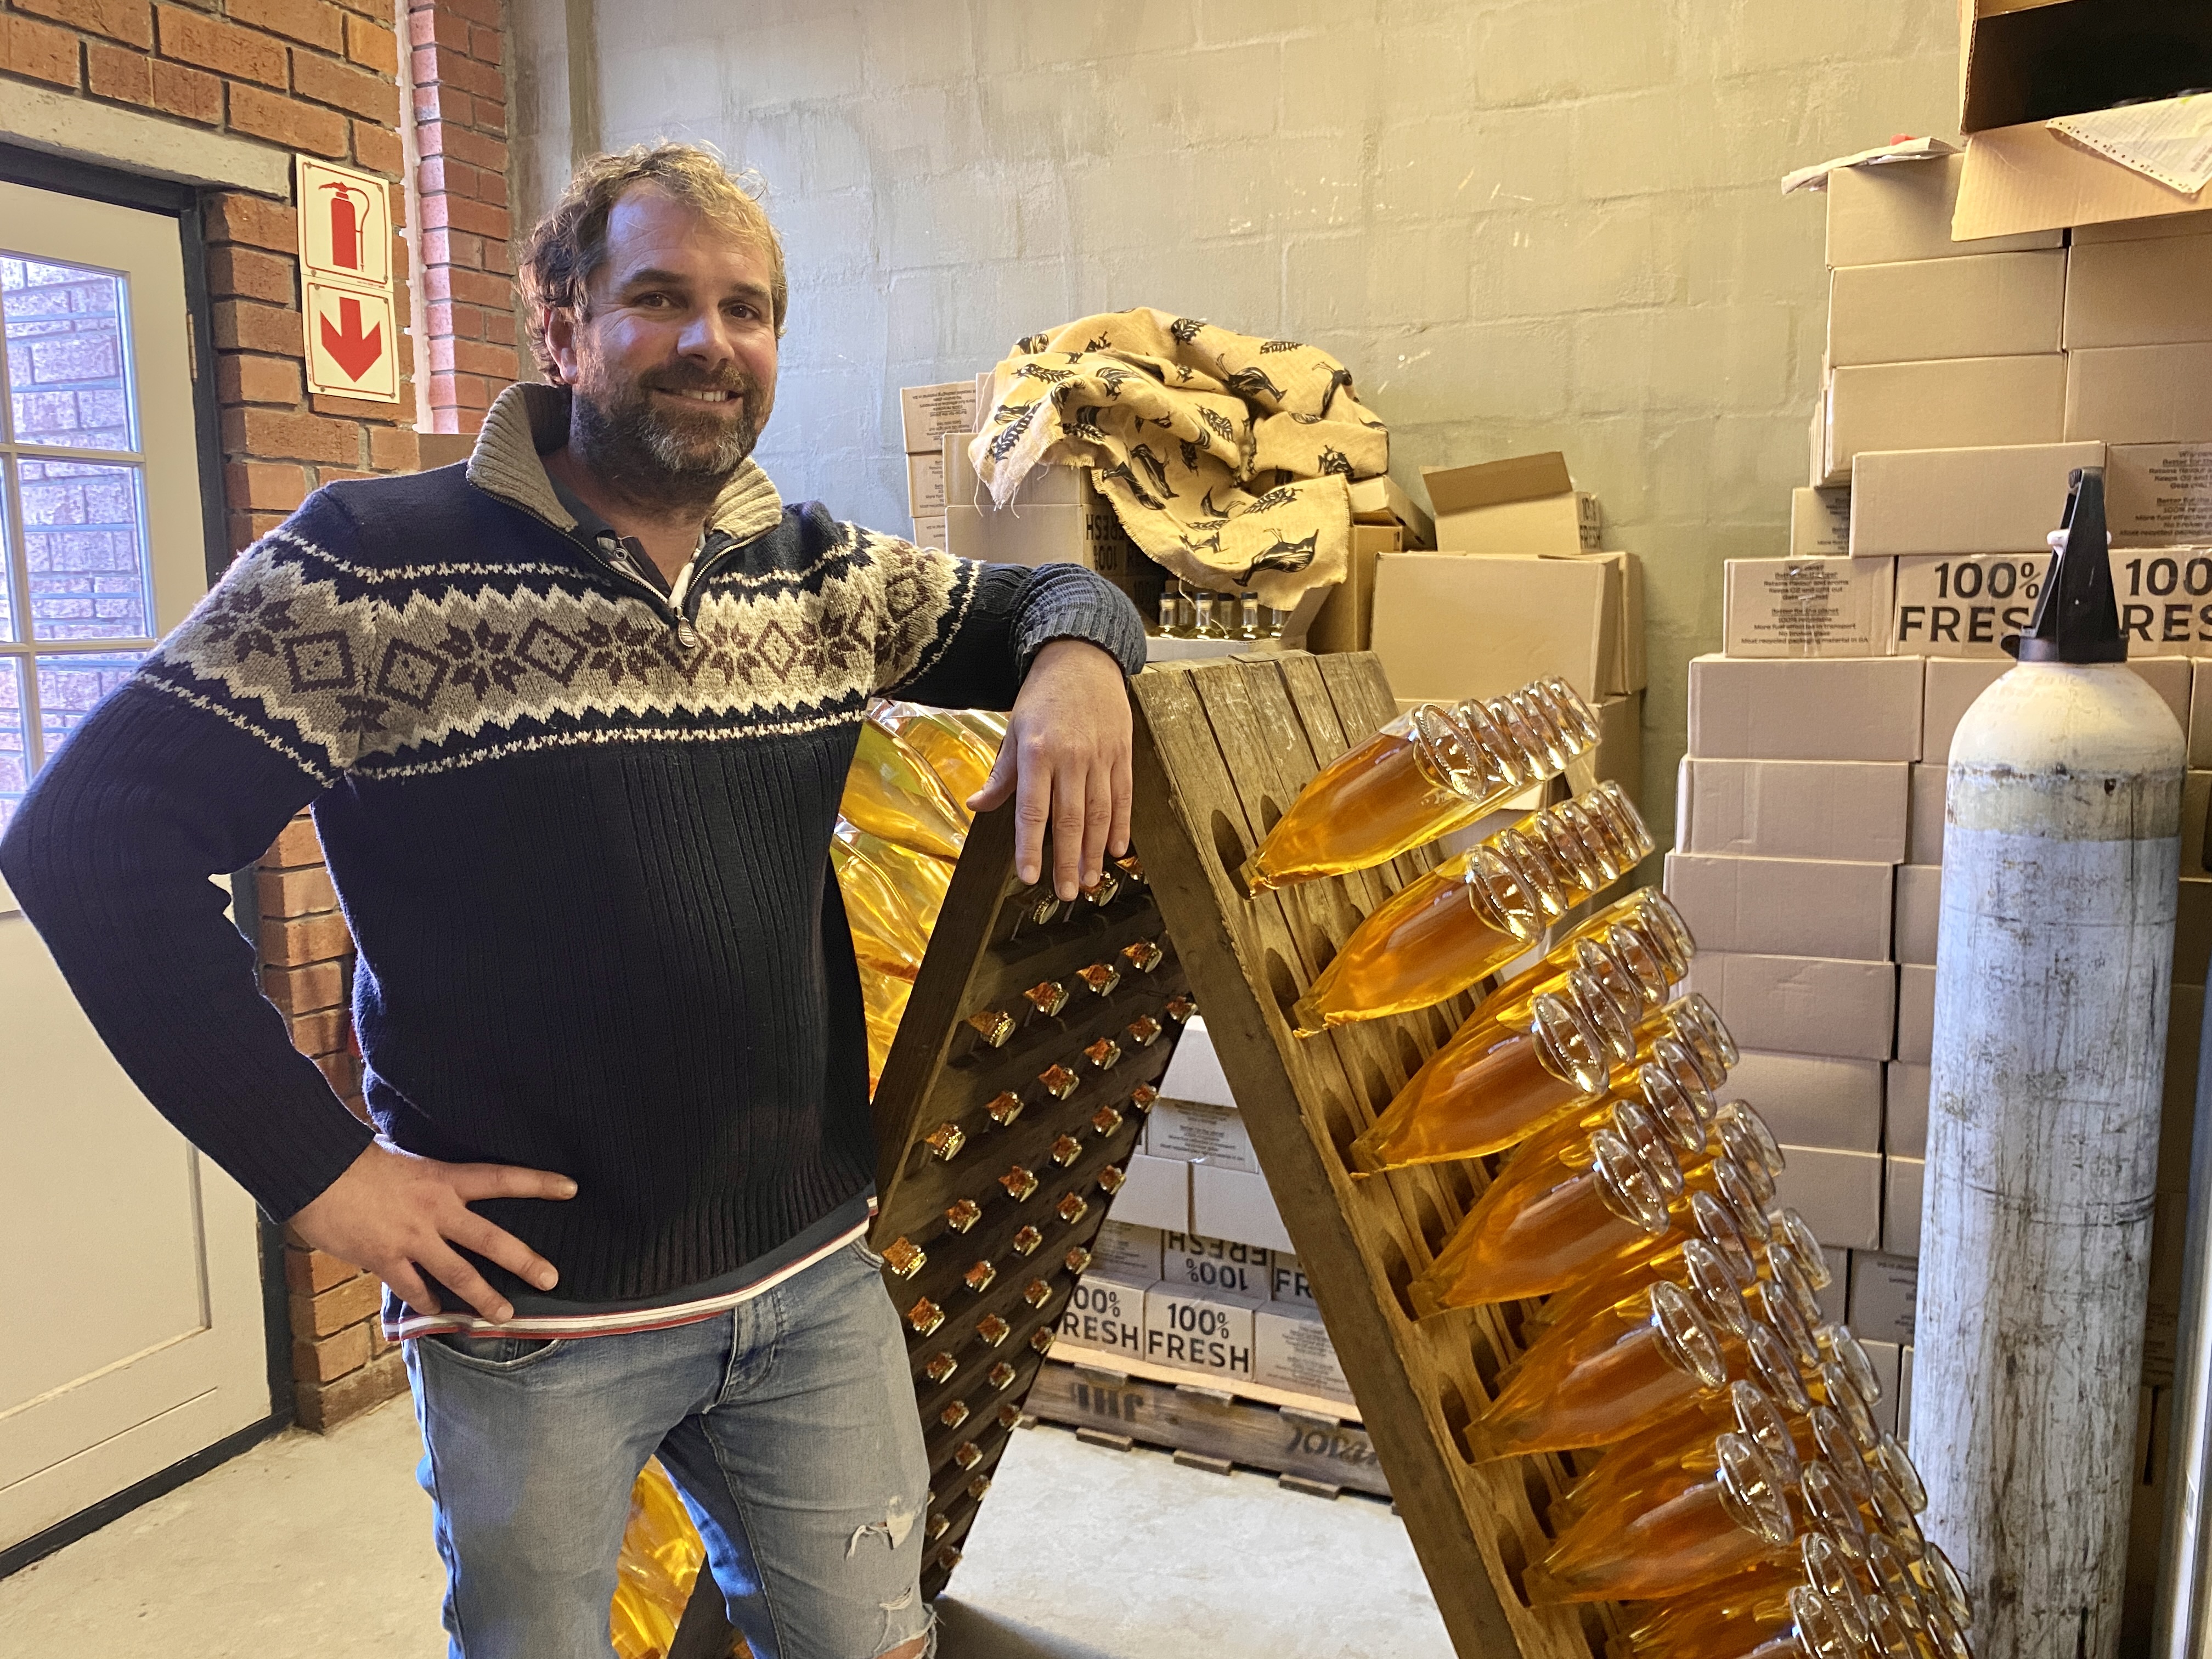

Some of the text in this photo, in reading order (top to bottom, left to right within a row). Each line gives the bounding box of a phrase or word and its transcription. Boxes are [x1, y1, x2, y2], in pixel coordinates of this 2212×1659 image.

[1934, 562, 2041, 599] 100%
[2125, 557, 2212, 596] 100
[1899, 606, 2029, 642] FRES
[1186, 1258, 1248, 1291] 100%
[1074, 1285, 1120, 1318] 00%
[1063, 1312, 1138, 1351] RESH
[1167, 1303, 1229, 1339] 100%
[1149, 1329, 1249, 1373] FRESH
